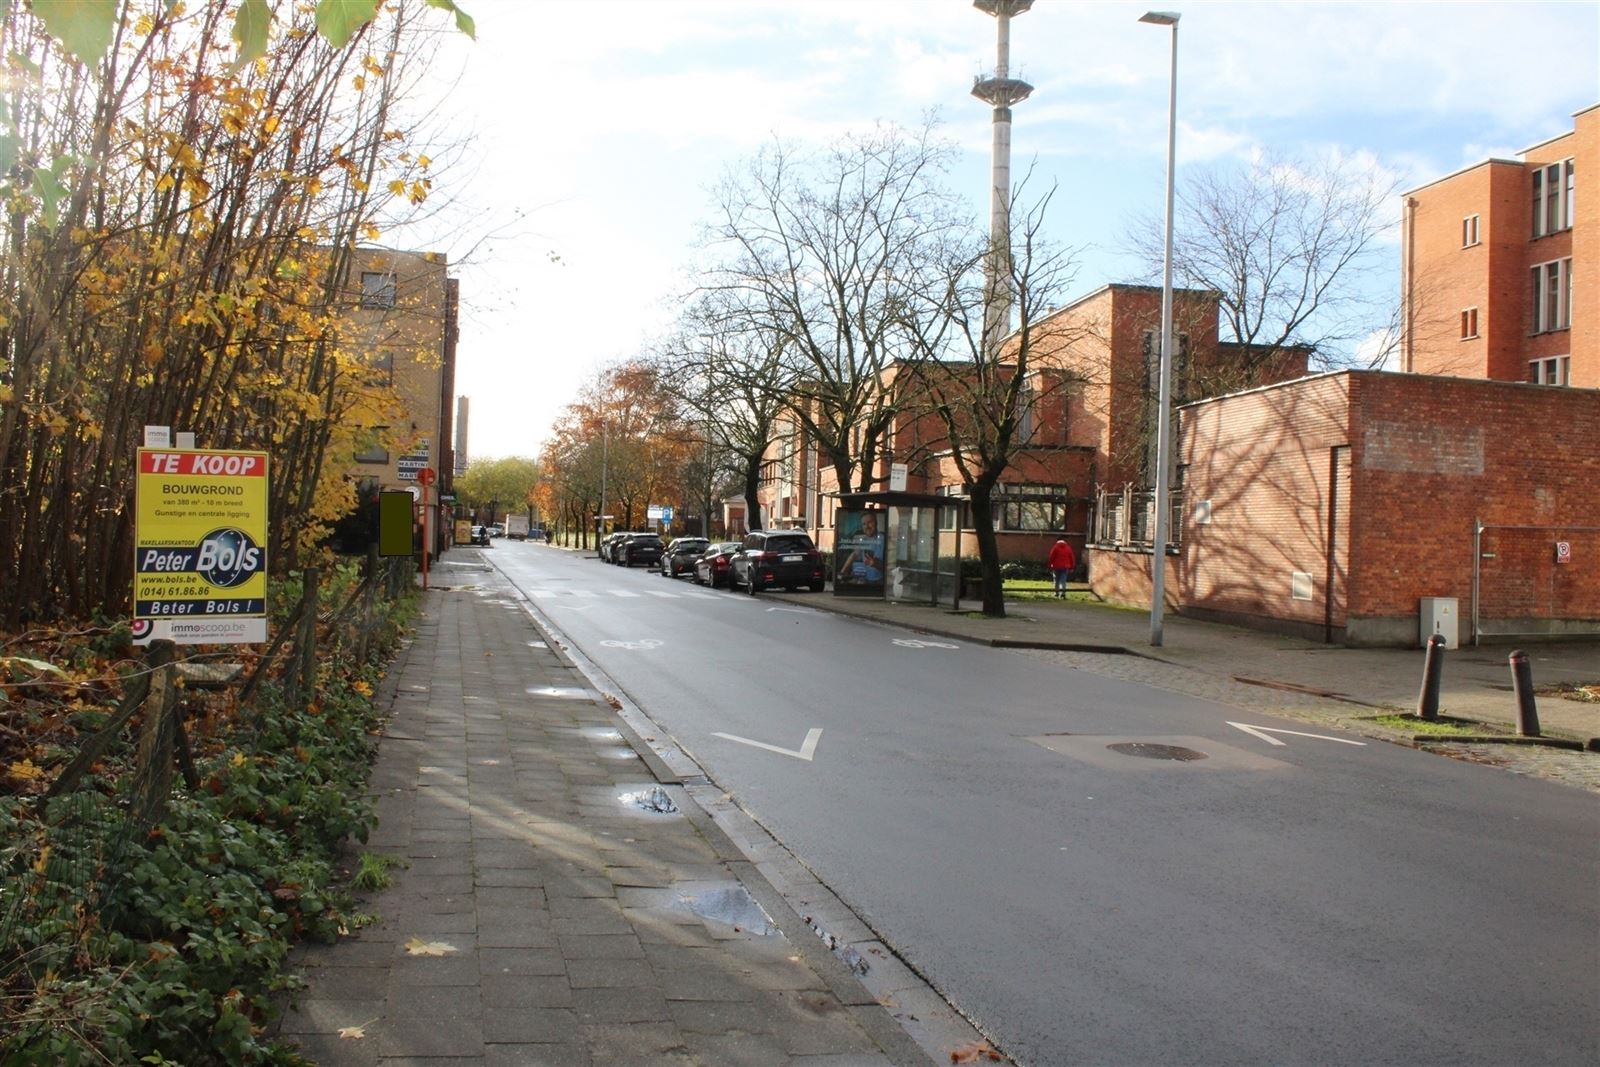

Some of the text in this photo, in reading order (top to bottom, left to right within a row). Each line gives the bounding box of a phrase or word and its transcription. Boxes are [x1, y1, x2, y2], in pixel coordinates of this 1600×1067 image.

[152, 454, 256, 475] TE KOOP
[162, 484, 244, 496] BOUWGROND
[155, 510, 186, 518] Gunstige
[142, 539, 260, 571] Peter Bols
[140, 587, 209, 598] (014) 61.86.86
[150, 600, 252, 614] Beter Bols !
[171, 623, 246, 632] immoscoop.be
